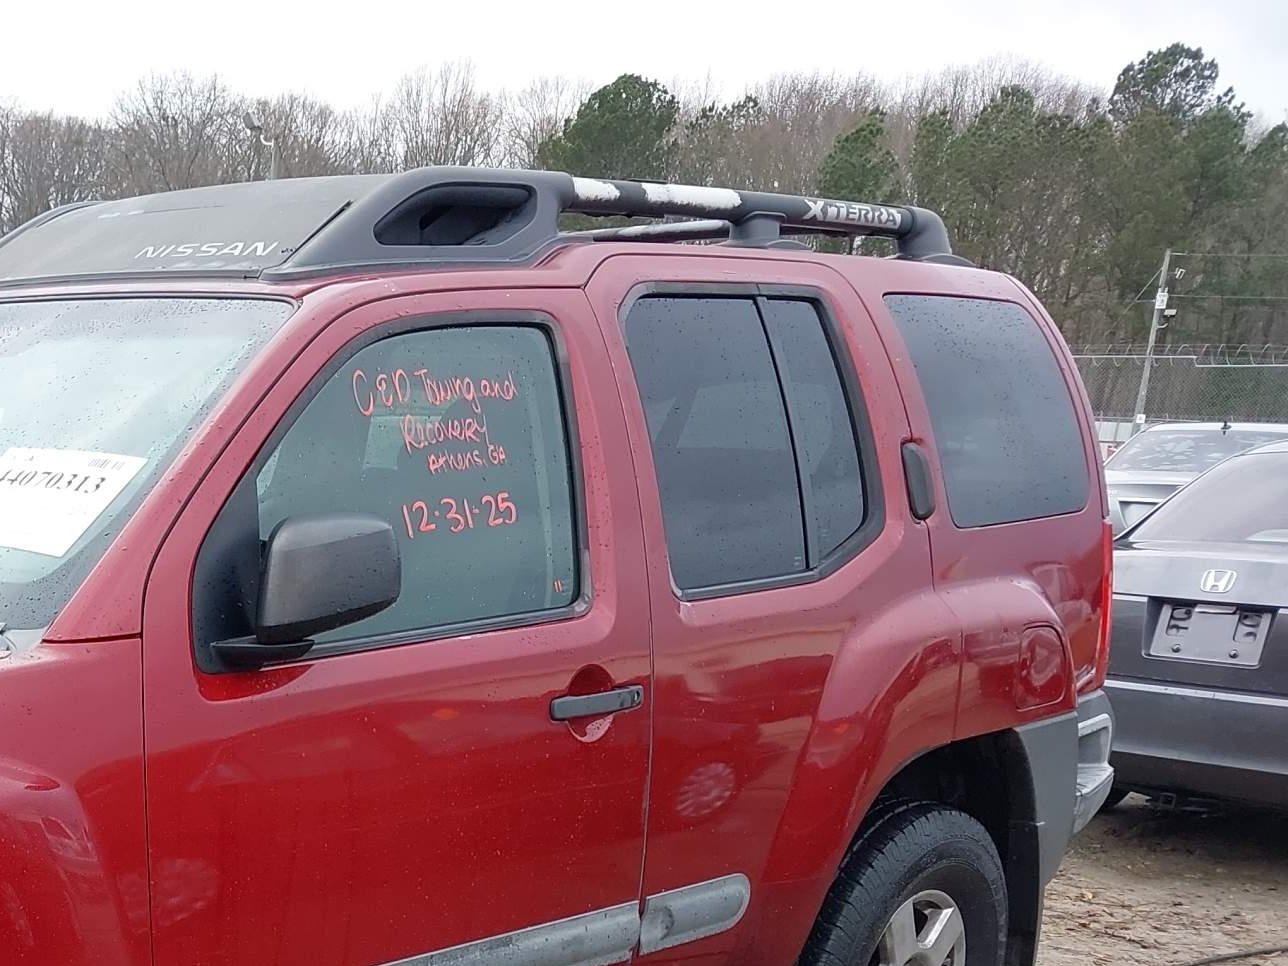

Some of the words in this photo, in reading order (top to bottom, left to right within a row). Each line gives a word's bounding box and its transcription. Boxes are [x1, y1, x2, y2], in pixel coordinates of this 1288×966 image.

[802, 199, 902, 229] XTERRA
[134, 241, 280, 258] NISSAN
[480, 370, 519, 401] and
[487, 444, 508, 465] GA
